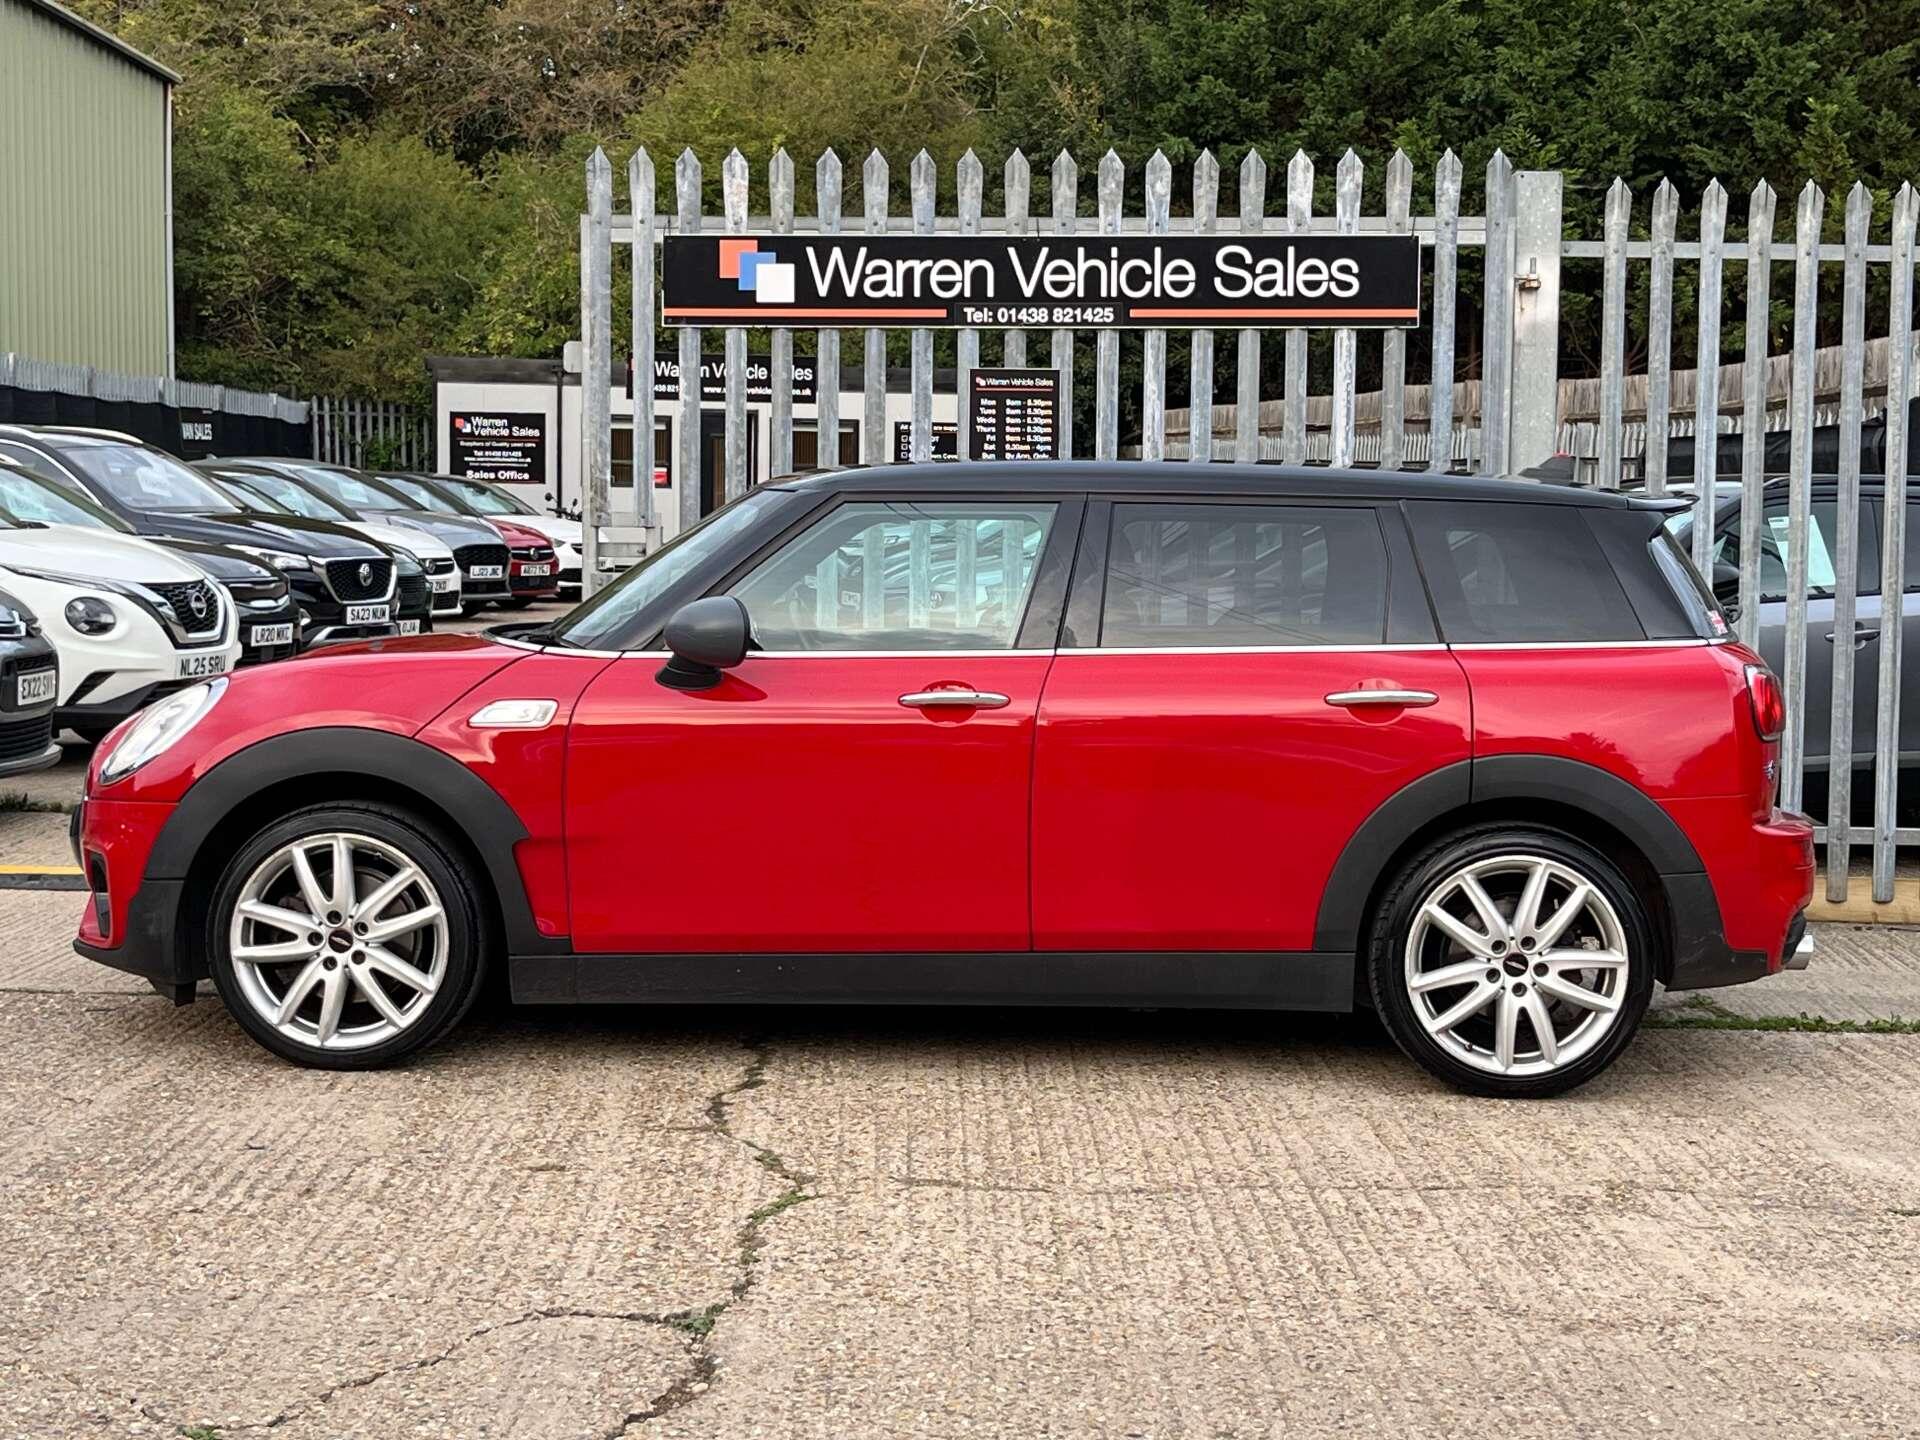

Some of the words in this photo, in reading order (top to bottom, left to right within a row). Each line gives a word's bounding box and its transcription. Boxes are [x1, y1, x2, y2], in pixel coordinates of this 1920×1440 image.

[805, 246, 995, 299] Warren
[1006, 246, 1197, 299] Vehicle
[1213, 244, 1361, 298] Sales
[963, 307, 993, 323] Tel:
[997, 307, 1049, 323] 01438
[1052, 307, 1115, 323] 821425
[655, 361, 710, 378] Wan
[471, 415, 508, 427] Warren
[194, 422, 213, 440] SALES
[472, 427, 510, 437] Vehicle
[511, 426, 540, 437] Sales
[466, 470, 496, 480] Sales
[497, 470, 530, 480] Office
[350, 607, 371, 621] SA23
[255, 627, 276, 643] LR20
[180, 656, 206, 676] NL25
[208, 655, 226, 673] SRU
[22, 676, 41, 700] EX22
